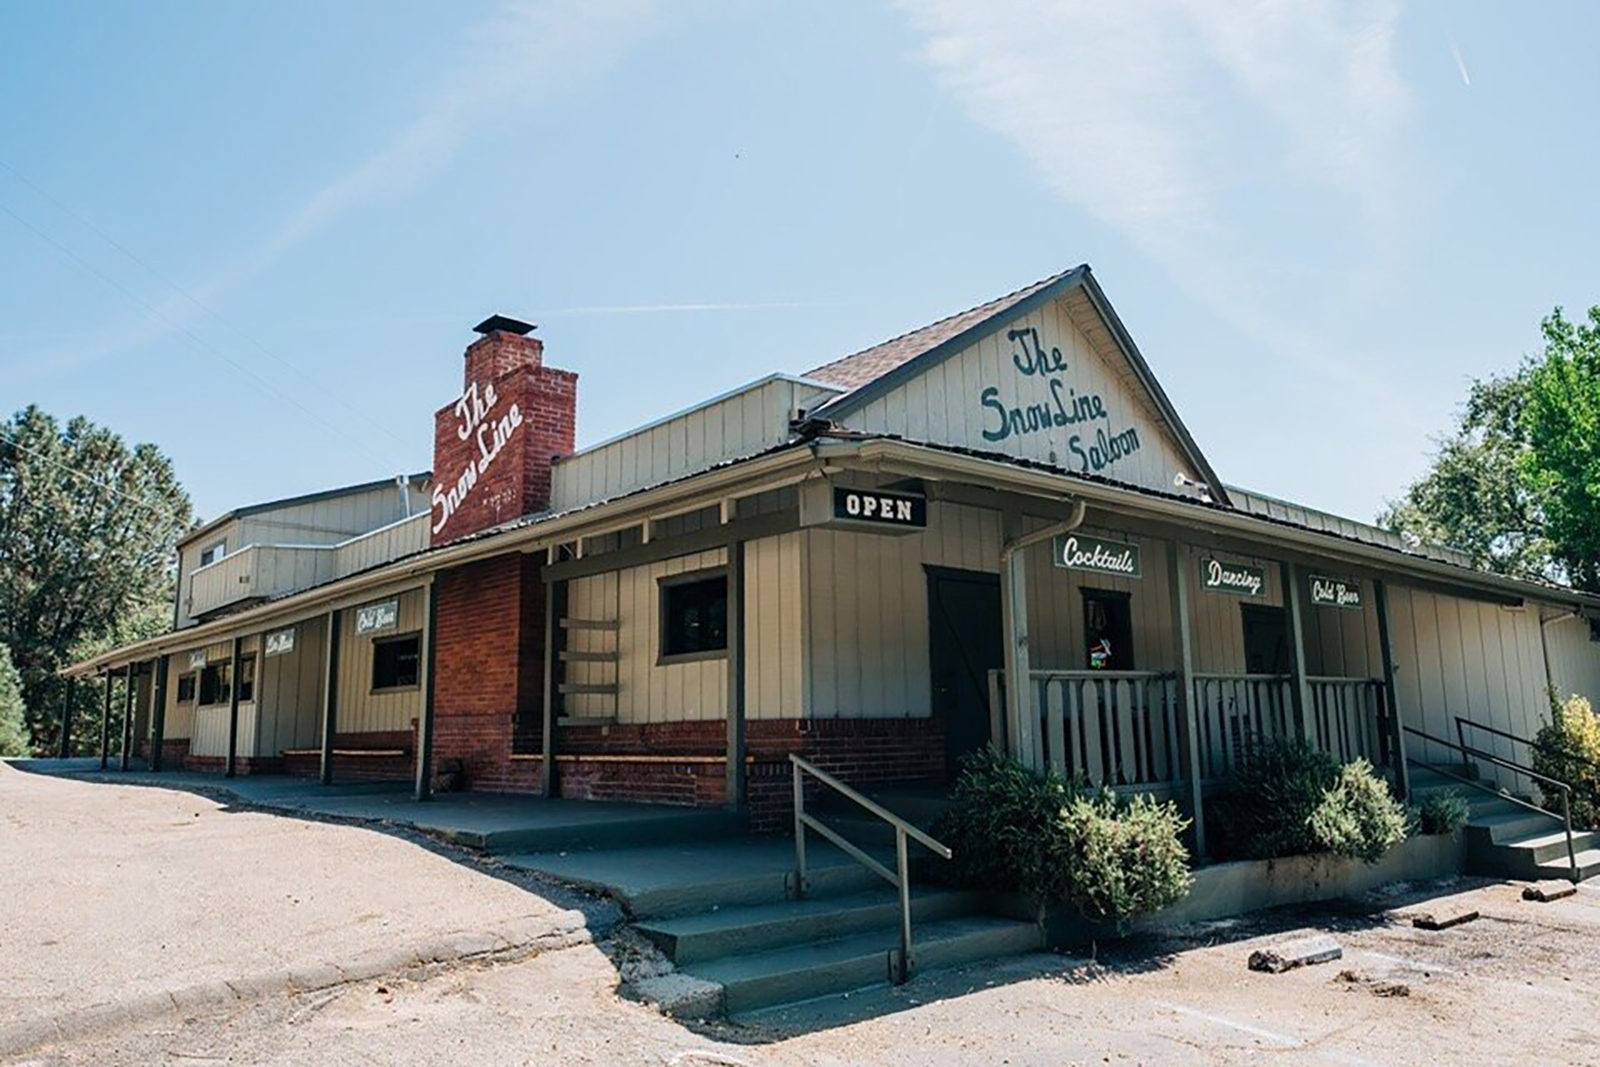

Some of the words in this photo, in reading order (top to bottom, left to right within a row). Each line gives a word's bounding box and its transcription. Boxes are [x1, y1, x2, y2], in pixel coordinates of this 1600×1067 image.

[1007, 327, 1067, 376] The
[455, 381, 498, 440] The
[1069, 428, 1140, 471] Saloon
[846, 494, 912, 520] OPEN
[1063, 537, 1134, 572] Cocktails
[1207, 560, 1261, 595] Dancing
[1313, 580, 1335, 601] Cold
[1336, 584, 1360, 605] Beer
